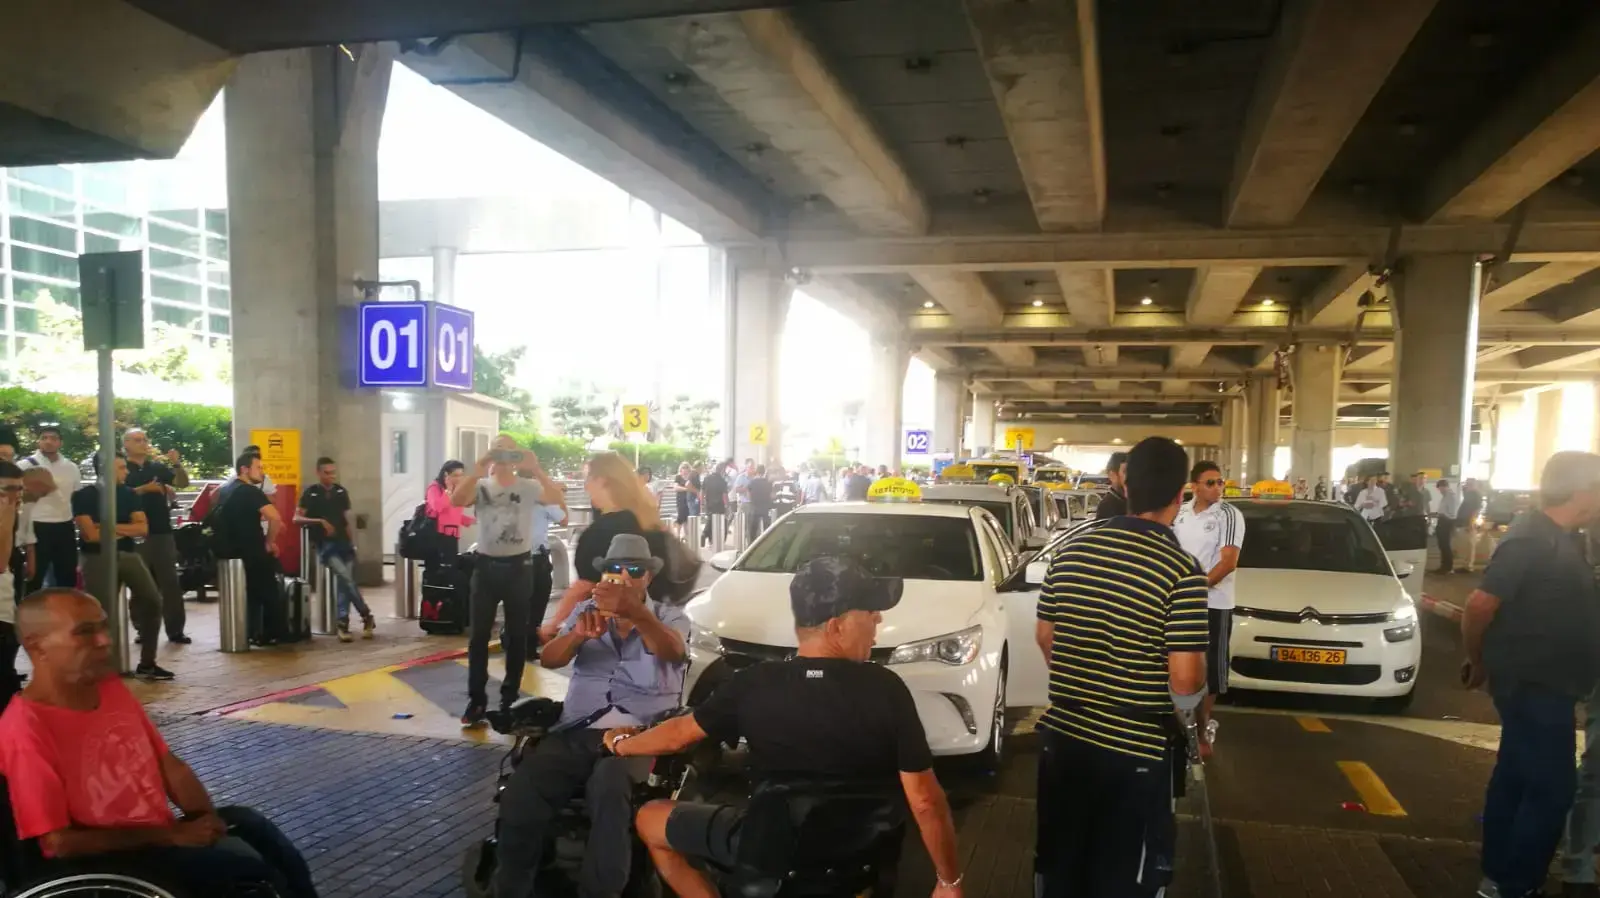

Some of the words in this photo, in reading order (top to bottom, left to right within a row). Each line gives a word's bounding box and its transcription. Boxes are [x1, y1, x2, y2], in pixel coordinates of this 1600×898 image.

[370, 319, 418, 370] 01
[438, 322, 469, 374] 01
[629, 408, 642, 428] 3
[754, 426, 764, 441] 2
[908, 434, 927, 449] 02
